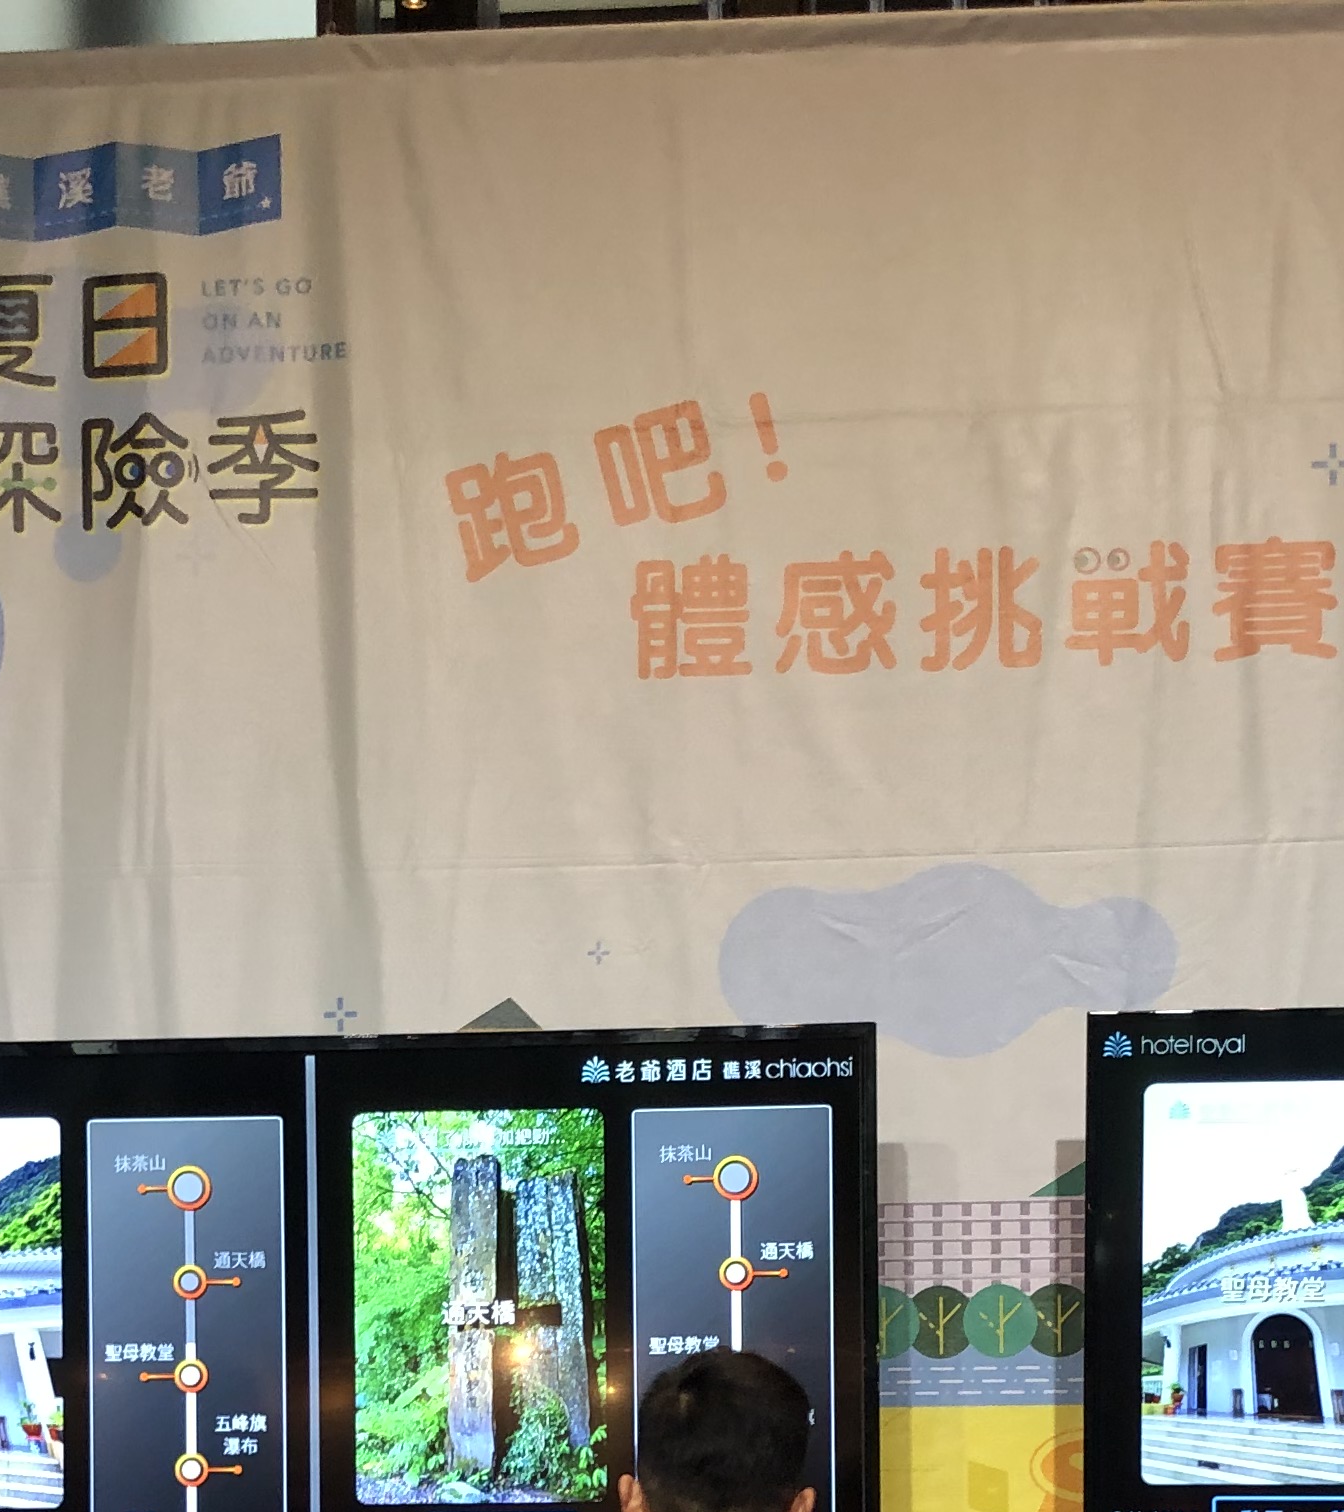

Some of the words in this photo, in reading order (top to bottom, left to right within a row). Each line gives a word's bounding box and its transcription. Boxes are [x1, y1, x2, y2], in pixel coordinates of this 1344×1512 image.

[201, 277, 266, 298] LET'S
[275, 276, 314, 297] GO
[202, 310, 238, 331] ON
[246, 309, 283, 330] AN
[201, 341, 348, 364] ADVENTURE
[629, 536, 1339, 681] 體感挑戰賽
[614, 1058, 713, 1083] 老爺酒店
[764, 1056, 854, 1080] chiaohsi
[114, 1154, 167, 1173] 抹茶山
[658, 1144, 713, 1164] 抹茶山
[213, 1250, 267, 1270] 通天橋
[759, 1240, 815, 1260] 通天橋
[1220, 1276, 1326, 1304] 聖母教堂
[441, 1299, 516, 1325] 通天橋
[104, 1343, 175, 1363] 聖母教堂
[214, 1413, 268, 1433] 五峰旗
[222, 1436, 259, 1456] 瀑布
